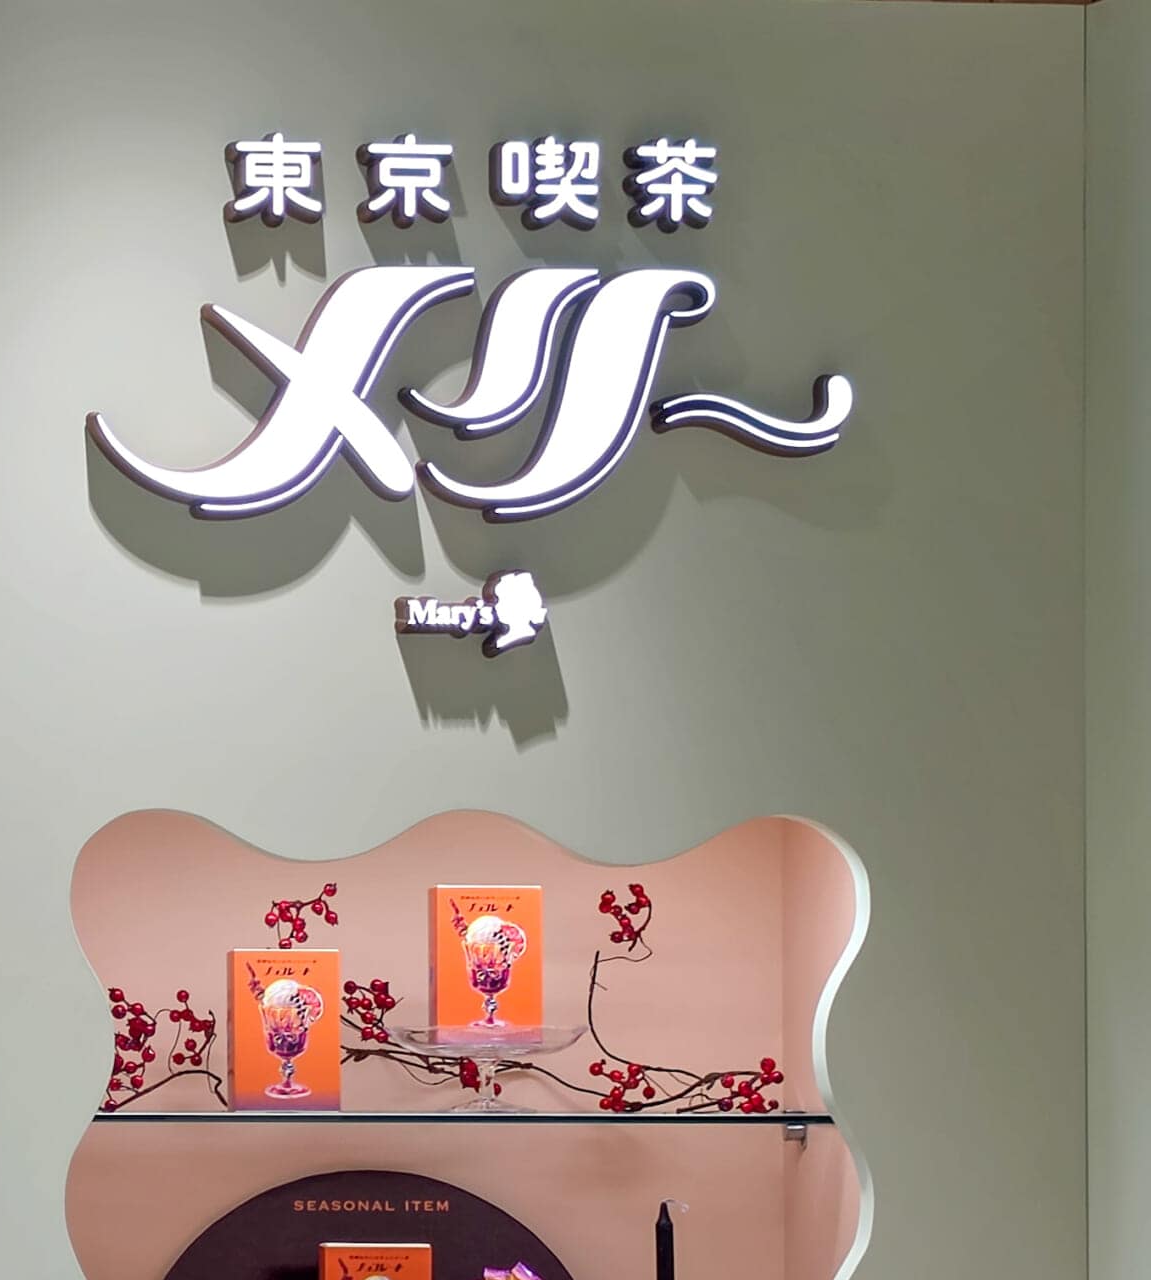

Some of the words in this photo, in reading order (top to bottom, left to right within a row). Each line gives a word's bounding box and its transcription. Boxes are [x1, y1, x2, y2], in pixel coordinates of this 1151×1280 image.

[227, 131, 718, 223] 東京喫茶
[86, 265, 853, 518] メリー
[404, 598, 495, 632] Mary's
[293, 1199, 396, 1212] SEASONAL
[404, 1199, 450, 1212] ITEM
